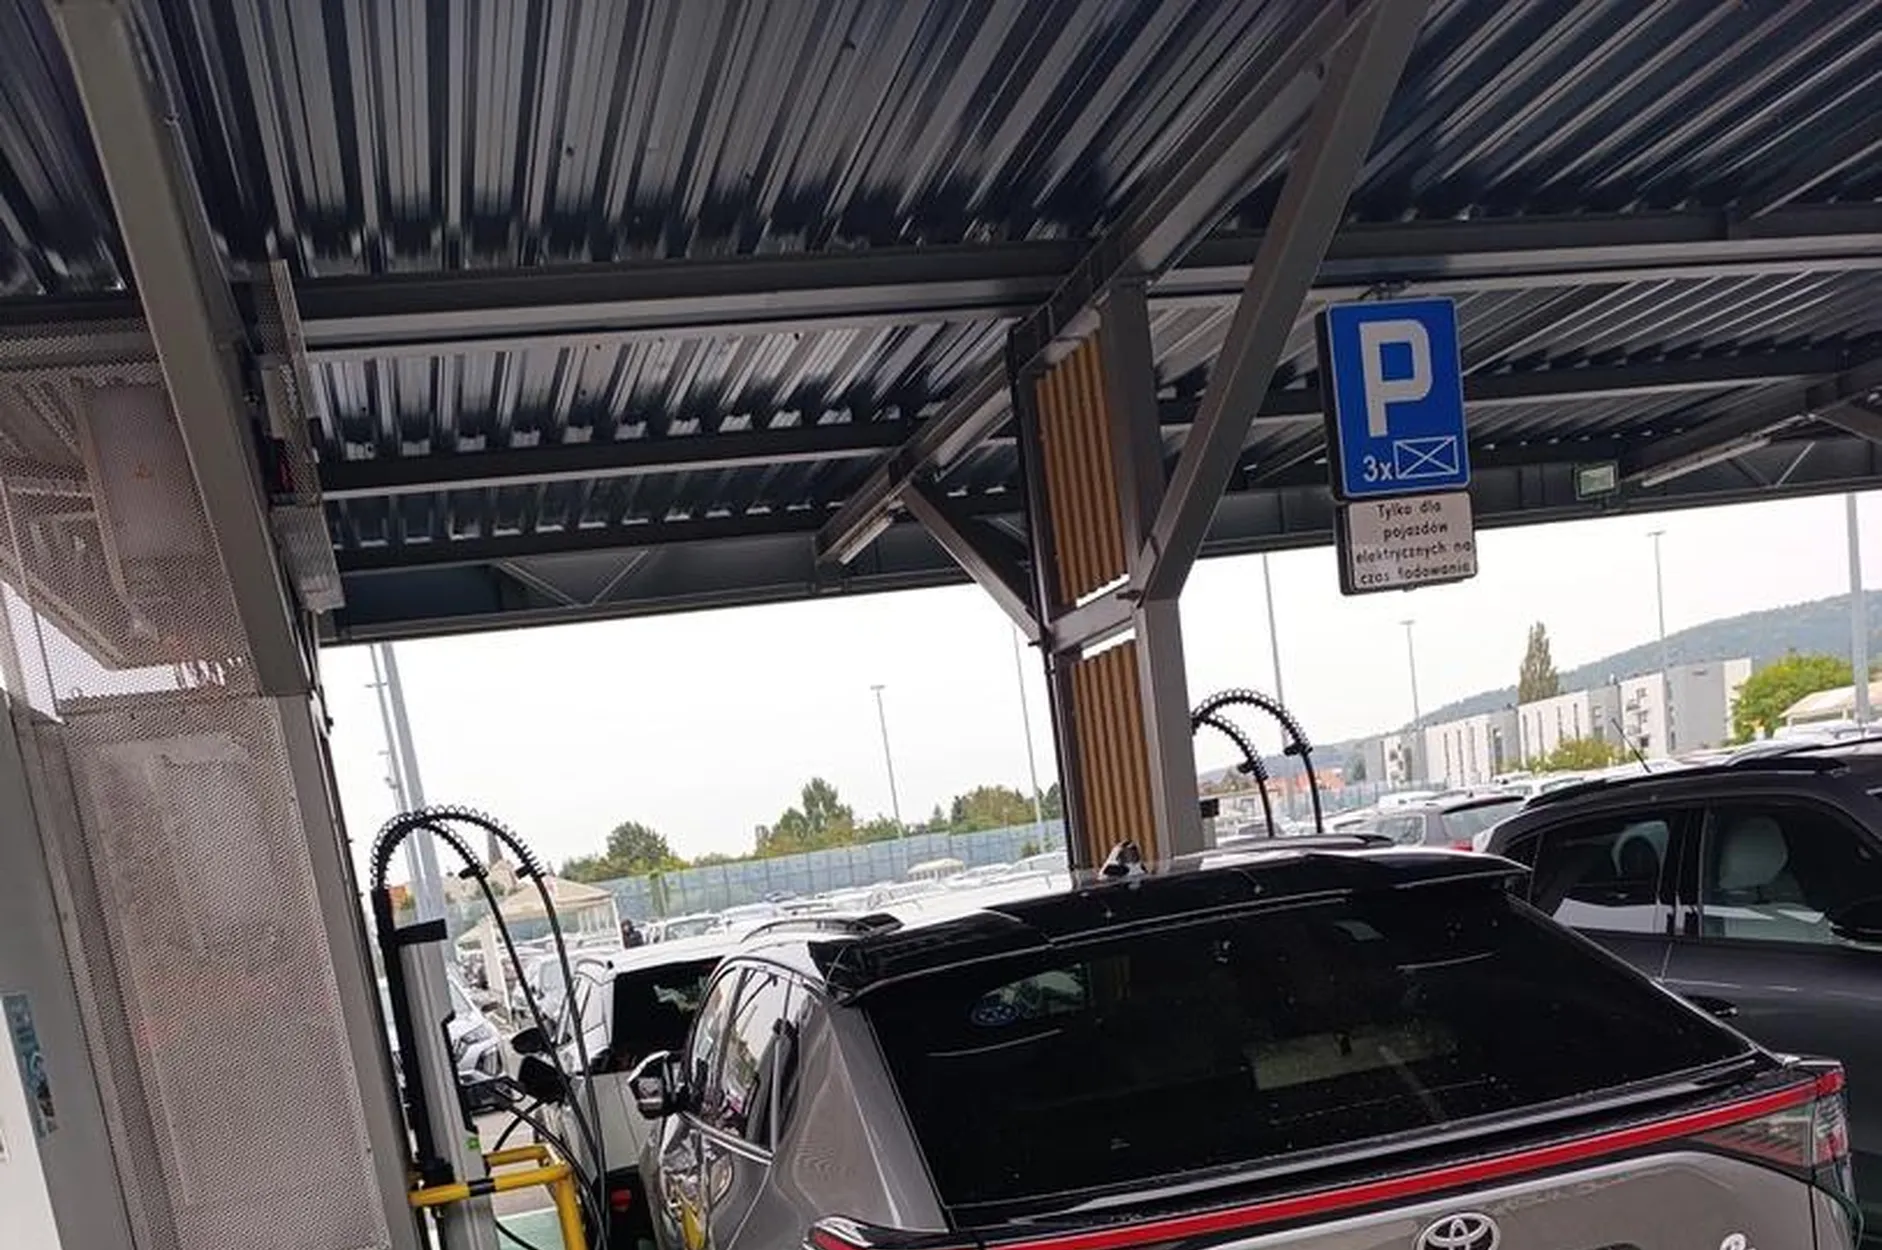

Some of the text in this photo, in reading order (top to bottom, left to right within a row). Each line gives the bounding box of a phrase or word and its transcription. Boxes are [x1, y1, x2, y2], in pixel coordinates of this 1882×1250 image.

[1359, 319, 1432, 437] P
[1363, 456, 1393, 482] 3x
[1377, 500, 1442, 521] Tylko dla
[1383, 520, 1448, 542] pojazdów
[1356, 540, 1472, 563] elektrycznych na
[1360, 571, 1390, 585] czas
